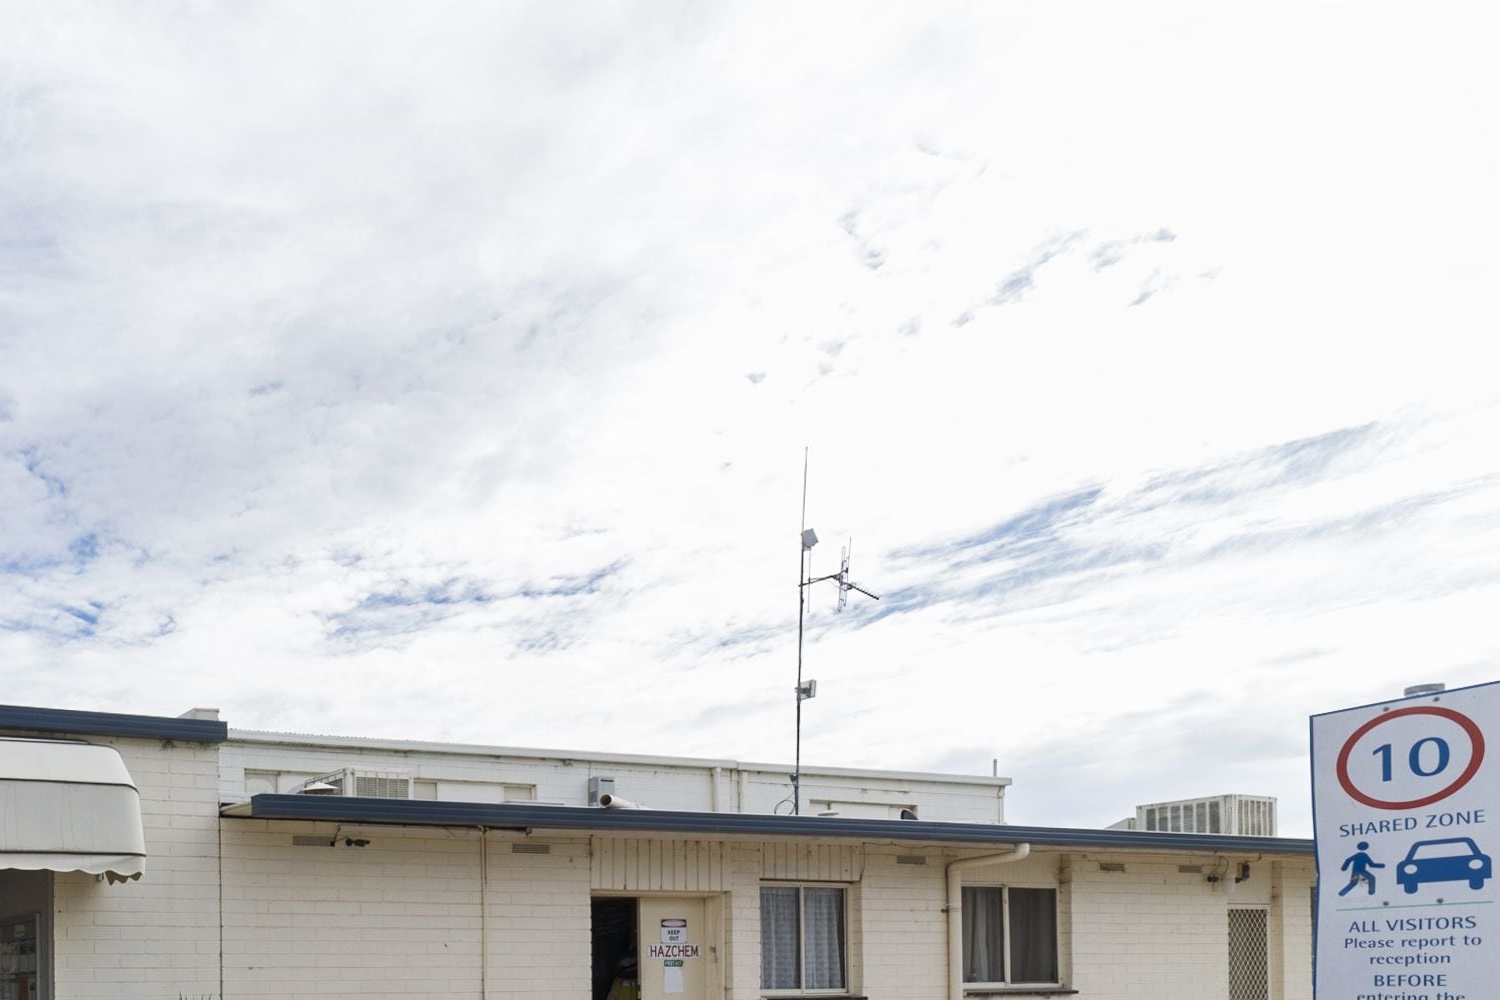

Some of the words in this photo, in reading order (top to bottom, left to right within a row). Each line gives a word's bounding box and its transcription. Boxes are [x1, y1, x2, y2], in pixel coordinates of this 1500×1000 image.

[1372, 736, 1450, 782] 10
[1339, 816, 1418, 838] SHARED
[1425, 809, 1486, 829] ZONE
[1348, 920, 1380, 933] ALL
[1386, 916, 1477, 932] VISITORS
[1344, 937, 1395, 949] Please
[1401, 936, 1456, 950] report
[1463, 935, 1482, 947] to
[650, 945, 699, 957] HAZCHEM
[1369, 953, 1451, 967] reception
[1374, 974, 1447, 987] BEFORE
